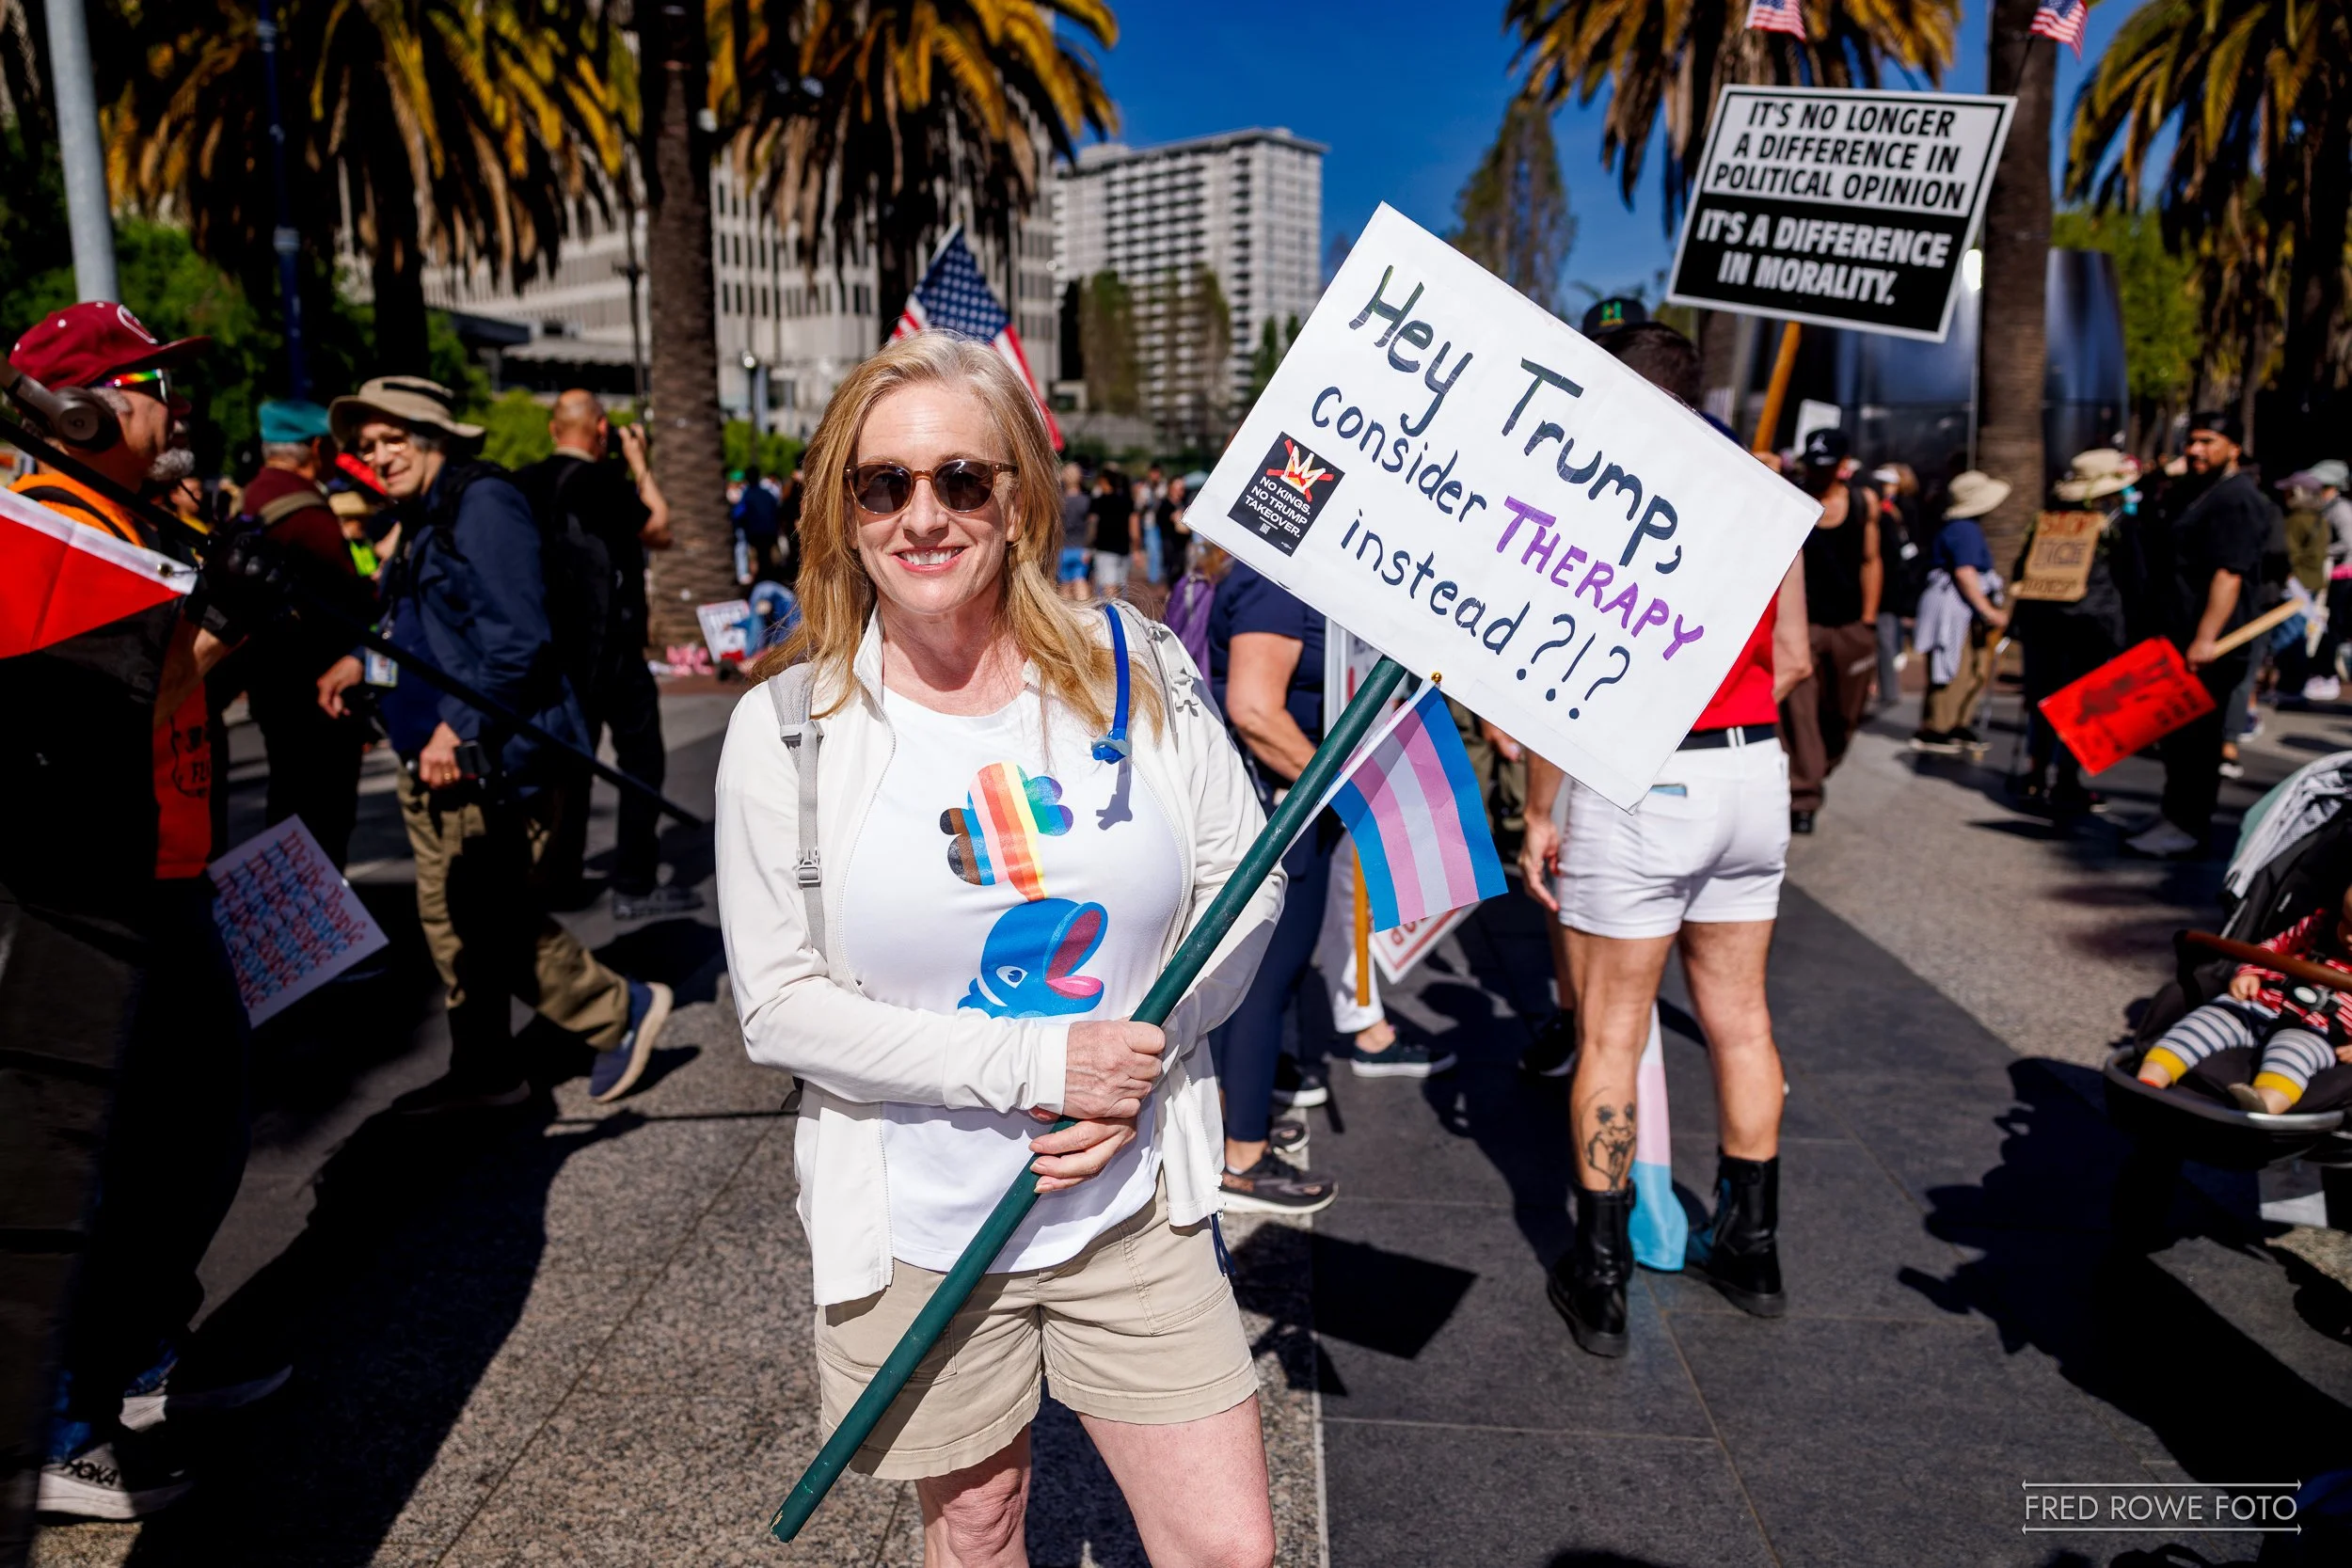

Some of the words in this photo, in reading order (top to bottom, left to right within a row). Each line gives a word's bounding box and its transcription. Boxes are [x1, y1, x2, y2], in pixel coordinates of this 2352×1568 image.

[1748, 102, 1793, 127] IT'S
[1799, 103, 1837, 130] NO
[1845, 105, 1957, 137] LONGER
[1733, 133, 1751, 157] A
[1758, 135, 1918, 170] DIFFERENCE
[1926, 146, 1961, 174] IN
[1713, 164, 1834, 198] POLITICAL
[1843, 174, 1966, 211] OPINION
[1696, 208, 1747, 245] IT'S
[1746, 214, 1771, 247] A
[1772, 217, 1952, 269] DIFFERENCE
[1717, 250, 1753, 284] IN
[1756, 256, 1898, 305] MORALITY.
[1349, 265, 1473, 436] Hey
[1502, 357, 1681, 574] Trump,
[1245, 495, 1300, 538] TAKEOVER.
[1251, 485, 1268, 500] NO
[1268, 496, 1308, 525] TRUMP
[1260, 476, 1277, 491] NO
[1276, 487, 1311, 515] KINGS.
[1311, 387, 1486, 522] consider
[1497, 496, 1704, 660] THERAPY
[60, 1459, 119, 1486] HOKA
